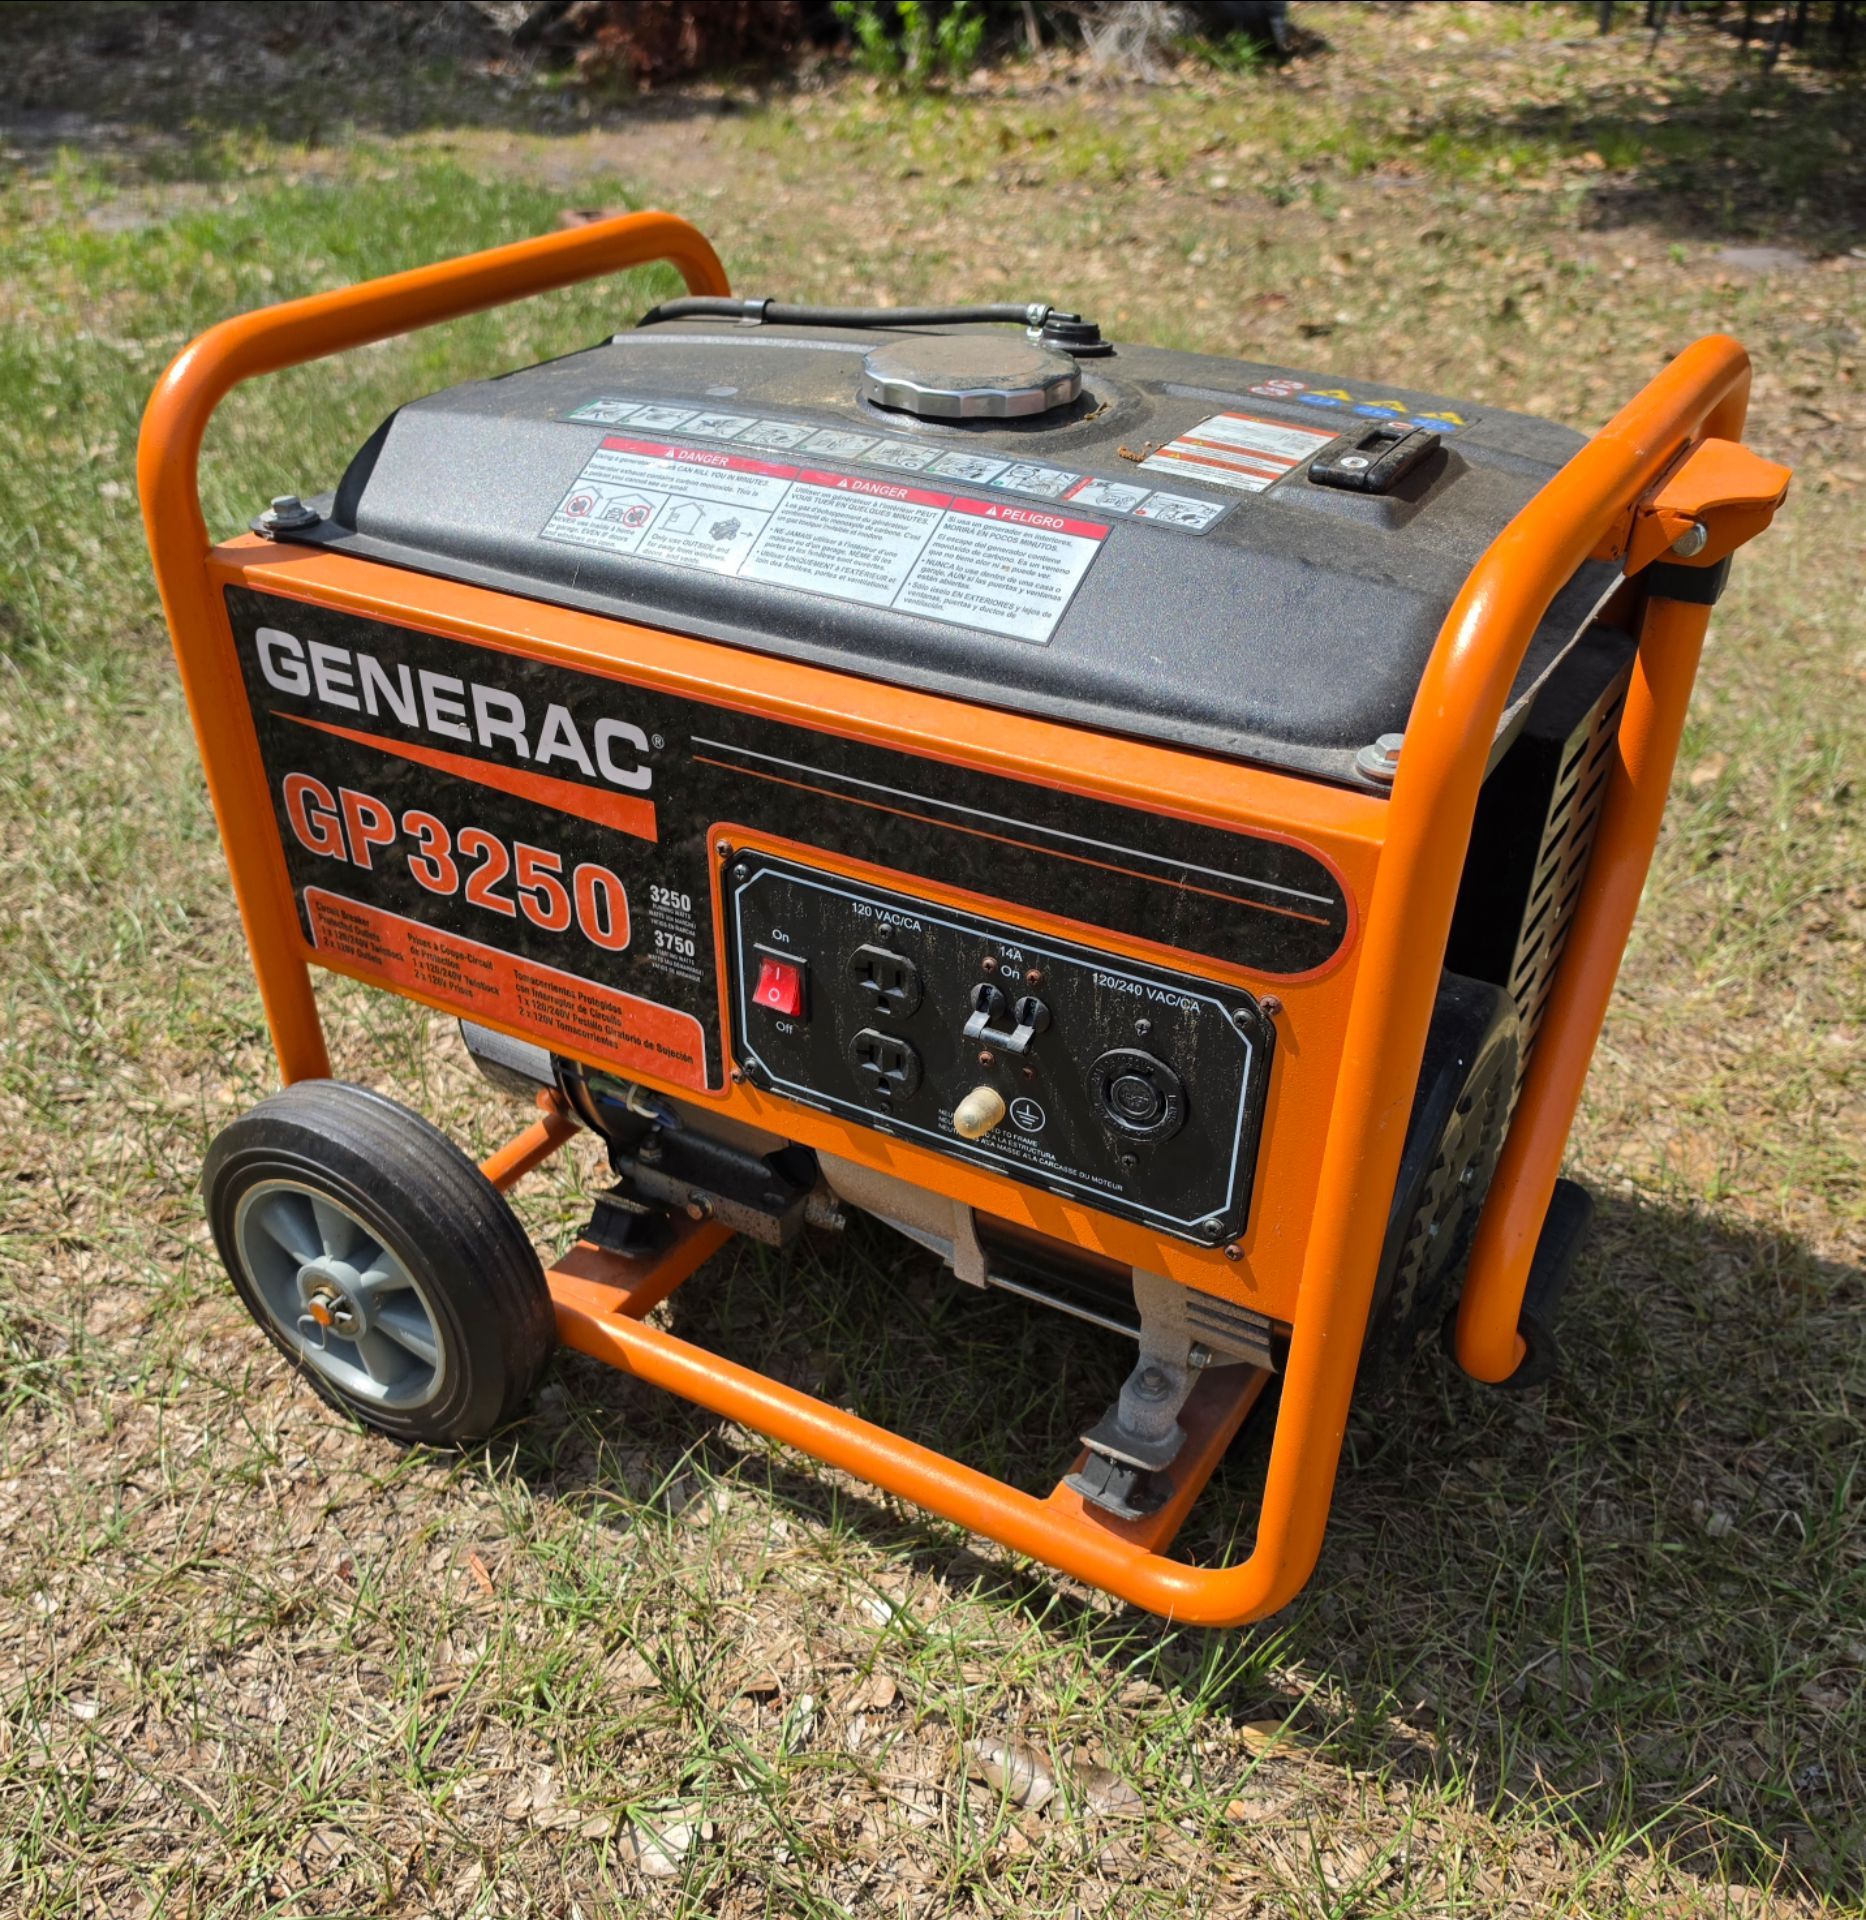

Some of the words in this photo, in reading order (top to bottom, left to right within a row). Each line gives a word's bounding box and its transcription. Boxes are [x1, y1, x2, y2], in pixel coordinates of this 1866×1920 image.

[678, 450, 729, 466] DANGER
[852, 480, 908, 498] DANGER
[1002, 509, 1064, 529] PELIGRO
[989, 532, 1018, 543] POCOS
[987, 544, 1026, 558] generador
[925, 558, 954, 570] NUNCA
[255, 627, 652, 791] GENERAC
[282, 772, 631, 952] GP3250
[649, 884, 691, 912] 3250
[852, 903, 872, 917] 120
[875, 909, 921, 932] VAC/CA
[654, 930, 695, 956] 3750
[772, 929, 789, 943] On
[1001, 946, 1023, 962] 14A
[1001, 965, 1020, 980] On
[1093, 973, 1142, 996] 120/240
[1147, 987, 1200, 1013] VAC/CA
[776, 1021, 792, 1034] Off
[1014, 1134, 1038, 1147] FRAME
[1008, 1139, 1056, 1161] ESTRUCTURA
[1039, 1157, 1077, 1175] CARCASSE
[1092, 1175, 1122, 1191] MOTEUR
